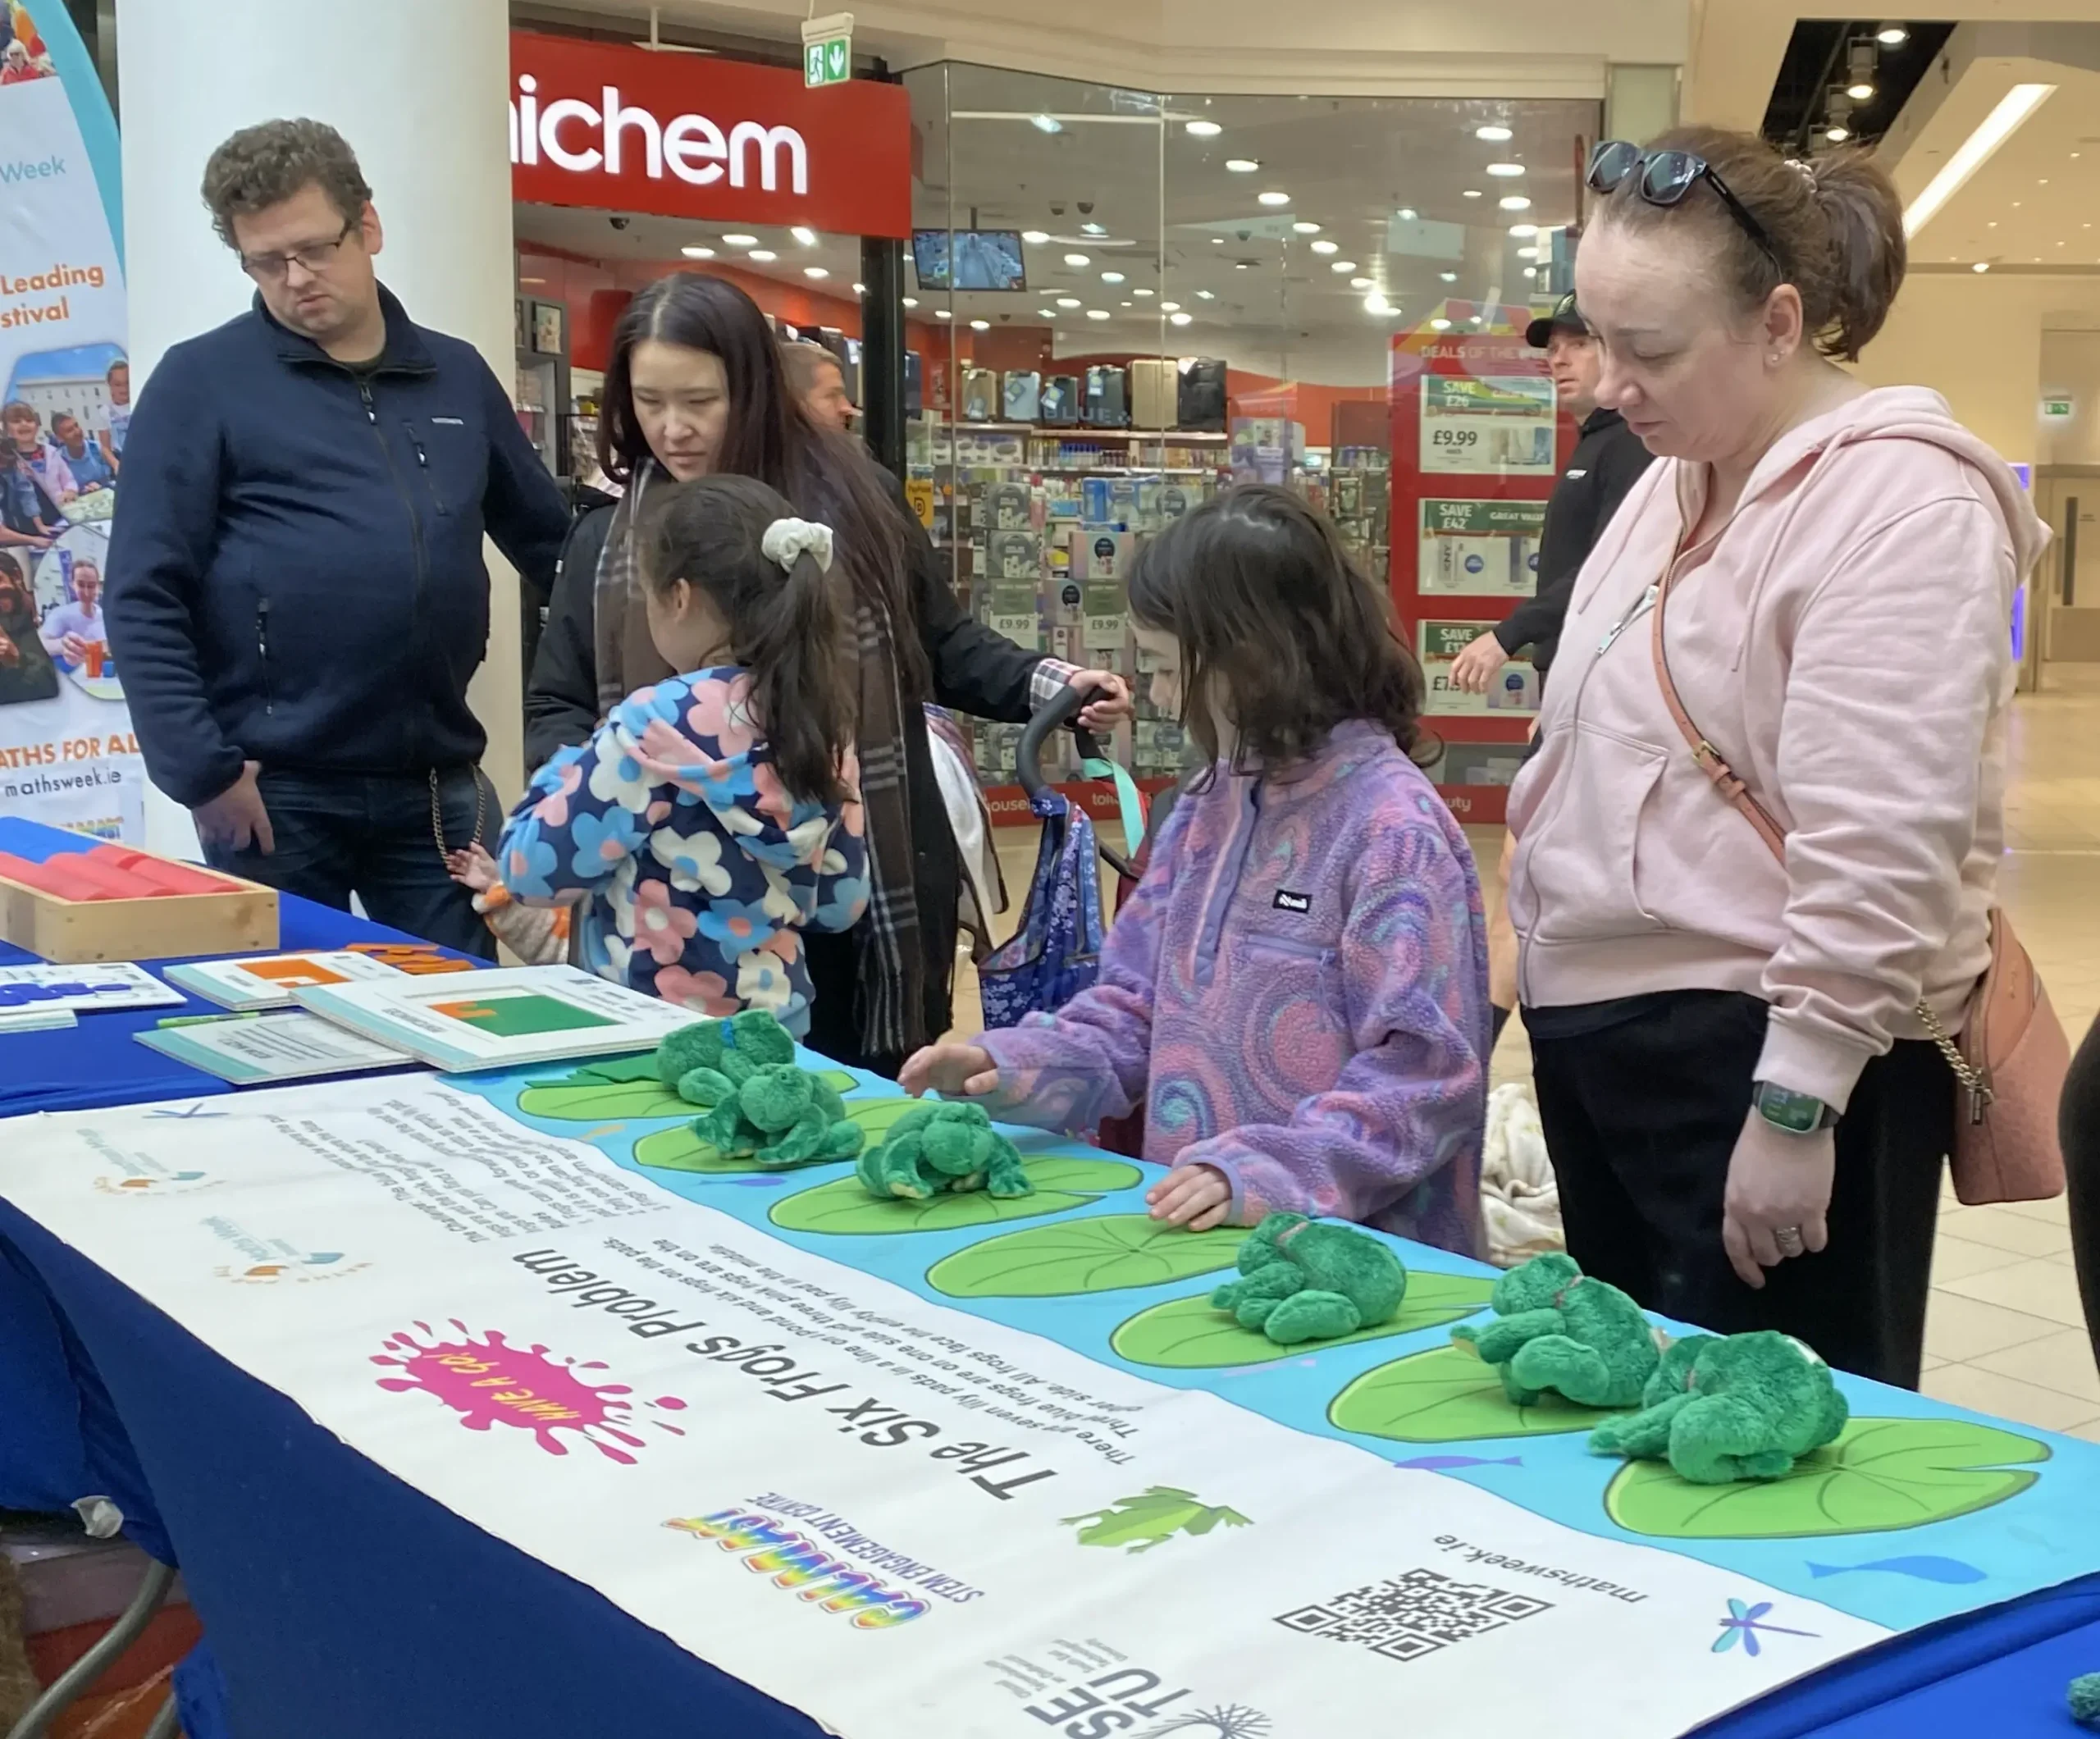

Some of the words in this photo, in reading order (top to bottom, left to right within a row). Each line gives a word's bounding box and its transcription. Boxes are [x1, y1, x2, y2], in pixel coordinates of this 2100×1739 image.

[0, 155, 66, 184] Week
[1, 263, 104, 295] Leading
[1420, 345, 1466, 358] DEALS
[1442, 380, 1477, 395] SAVE
[1433, 430, 1478, 447] £9.99
[1439, 504, 1472, 518] SAVE
[1443, 518, 1467, 530] £42
[999, 618, 1030, 631] £9.99
[1092, 618, 1118, 631] £9.99
[1440, 628, 1473, 641] SAVE
[62, 737, 101, 761] FOR
[5, 765, 122, 797] mathsweek.ie
[532, 1212, 568, 1229] Rules
[463, 1231, 490, 1243] The
[653, 1239, 680, 1253] the
[636, 1257, 664, 1269] the
[695, 1261, 724, 1273] are
[658, 1268, 683, 1278] on
[513, 1248, 707, 1338] Problem
[678, 1277, 720, 1293] frogs
[792, 1284, 835, 1297] pad
[714, 1291, 744, 1302] six
[755, 1287, 801, 1303] pink
[733, 1301, 774, 1316] and
[791, 1303, 834, 1324] three
[762, 1316, 818, 1336] pond
[897, 1345, 934, 1361] one
[929, 1337, 970, 1353] face
[424, 1353, 498, 1373] GO!
[844, 1346, 880, 1363] line
[967, 1352, 1017, 1374] frogs
[685, 1335, 853, 1401] Frogs
[889, 1367, 915, 1376] in
[930, 1360, 959, 1371] on
[471, 1377, 516, 1386] A
[911, 1375, 963, 1394] pads
[956, 1372, 991, 1384] are
[1009, 1373, 1047, 1385] All
[987, 1384, 1040, 1406] frogs
[1048, 1384, 1092, 1401] side.
[493, 1390, 578, 1420] HAVE
[952, 1394, 989, 1409] lily
[985, 1407, 1044, 1428] seven
[1037, 1404, 1089, 1421] blue
[825, 1397, 941, 1447] Six
[1076, 1431, 1134, 1464] There
[929, 1442, 1059, 1500] The
[746, 1492, 822, 1518] CENTRE
[806, 1514, 933, 1579] ENGAGEMENT
[660, 1507, 933, 1631] CALMAST
[1432, 1533, 1649, 1603] mathsweek.ie
[914, 1567, 984, 1604] STEM
[1087, 1668, 1194, 1718] TU
